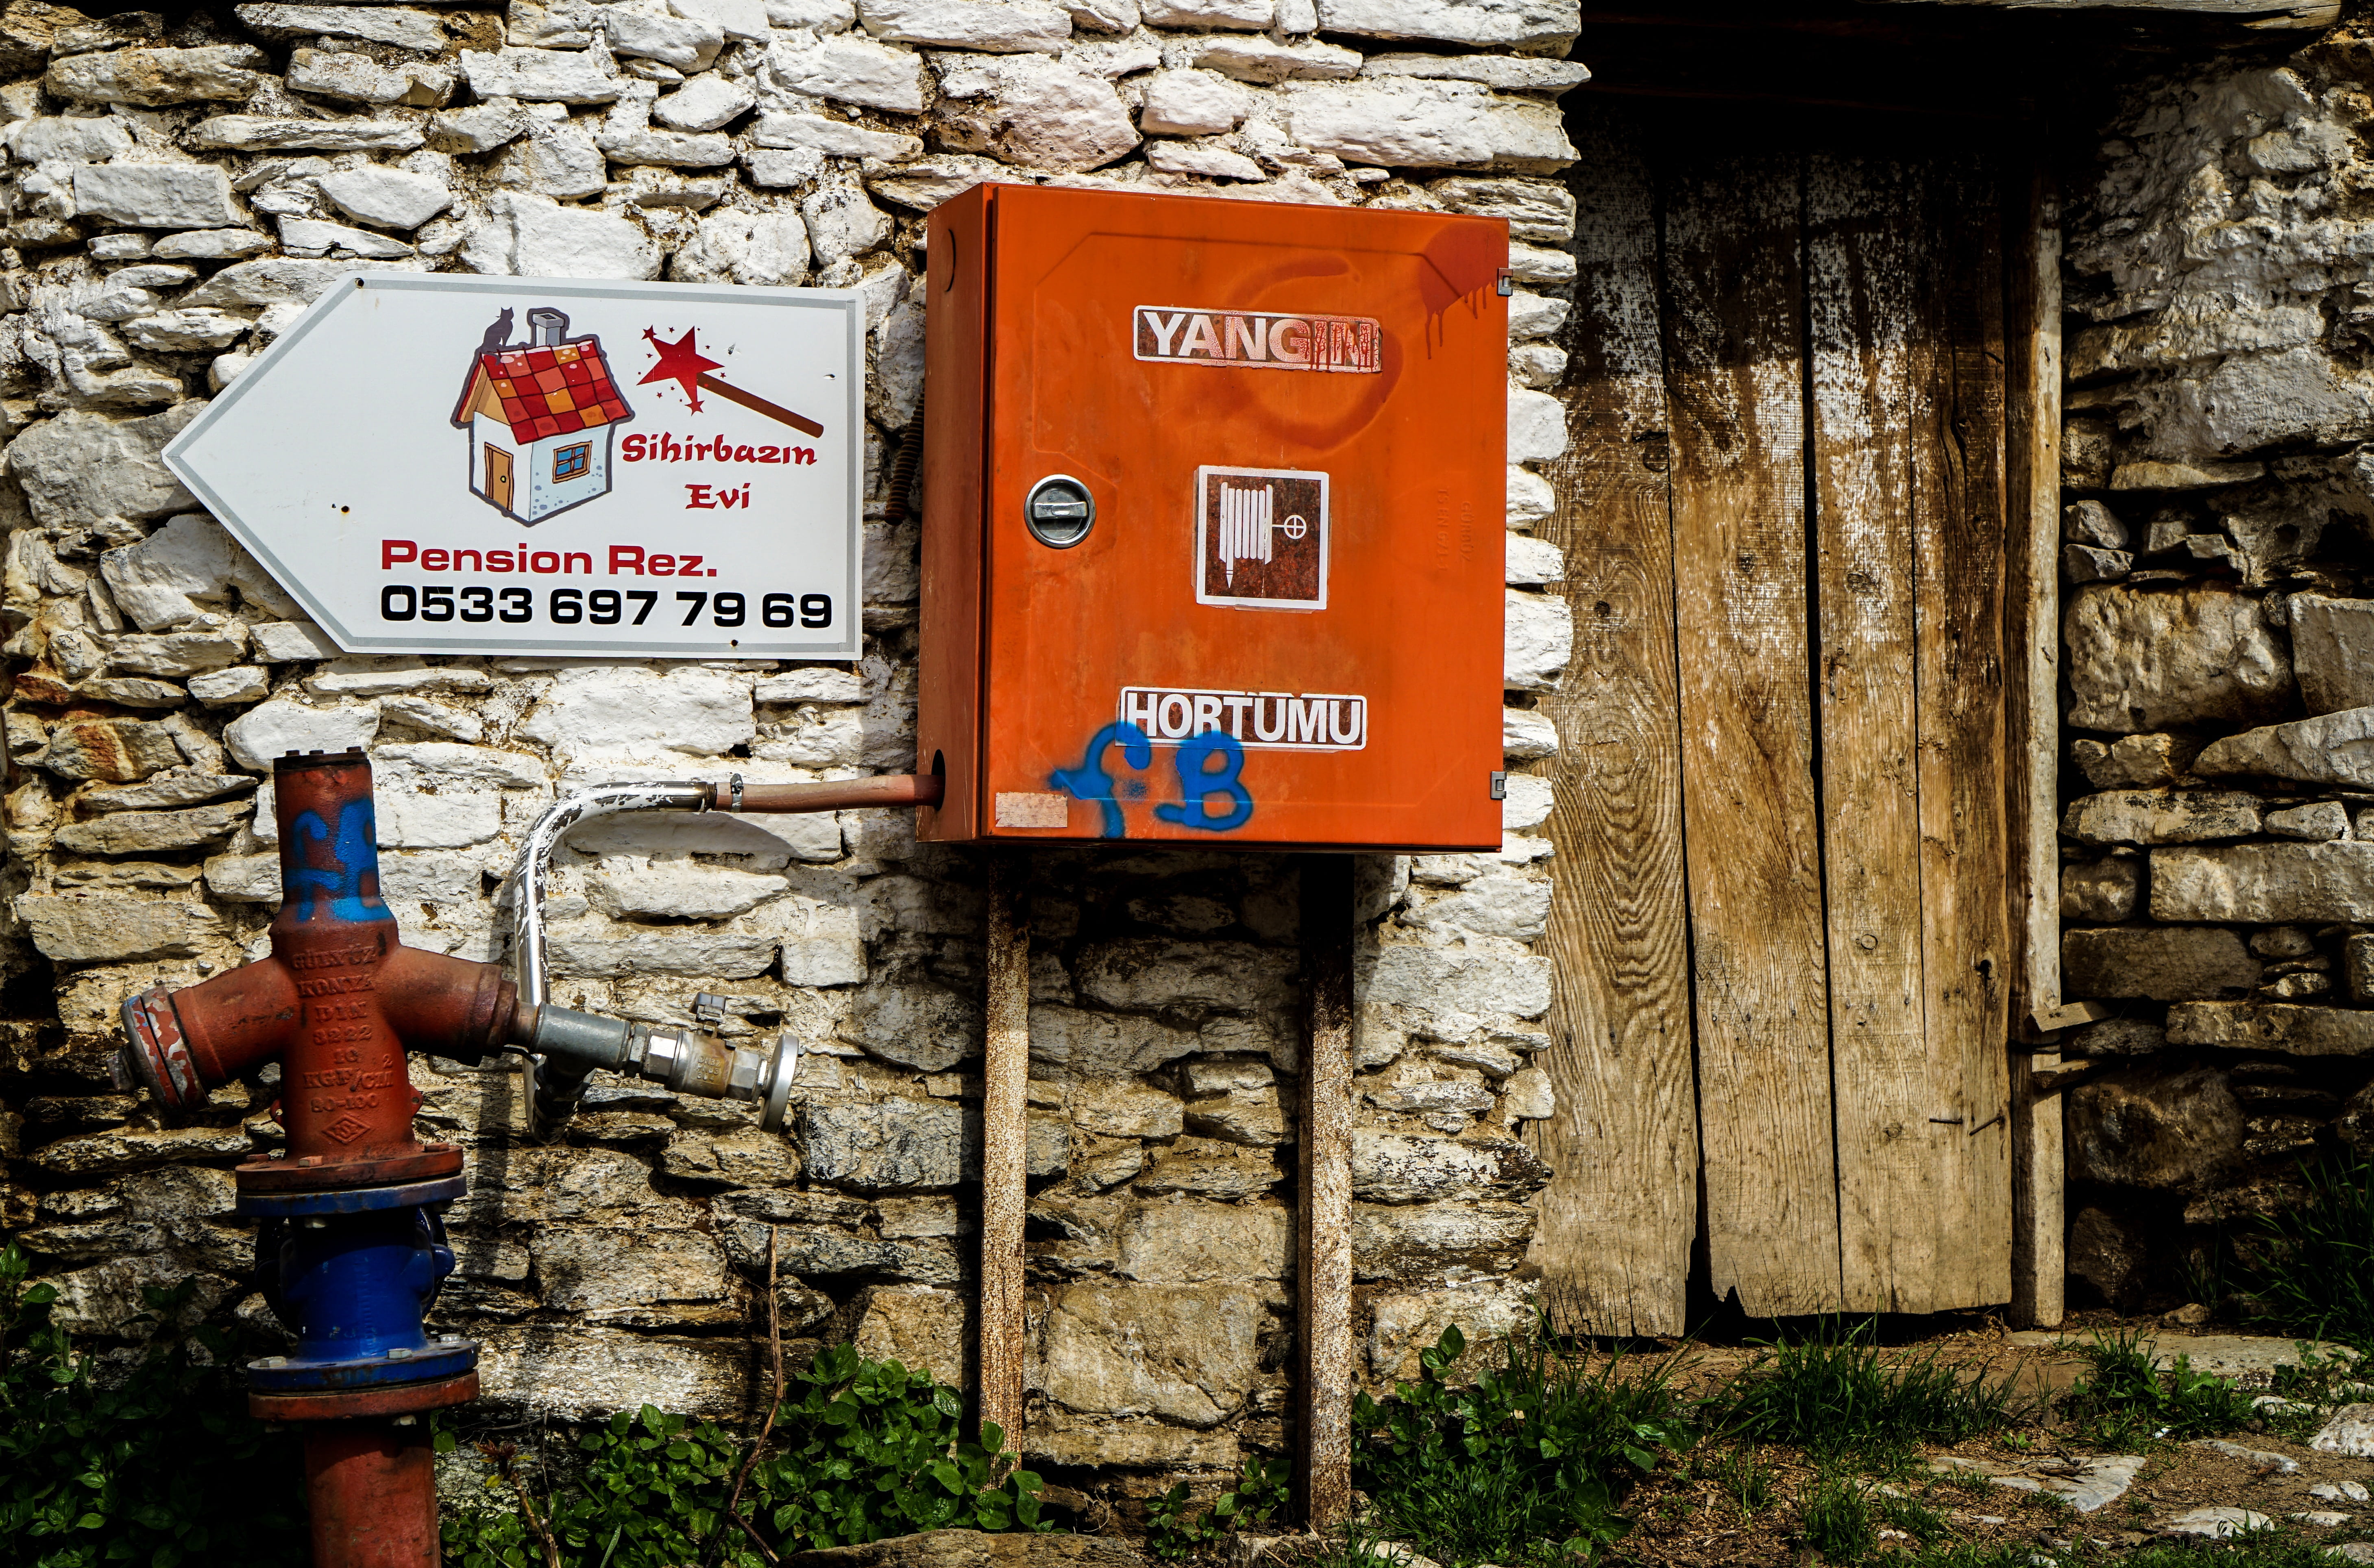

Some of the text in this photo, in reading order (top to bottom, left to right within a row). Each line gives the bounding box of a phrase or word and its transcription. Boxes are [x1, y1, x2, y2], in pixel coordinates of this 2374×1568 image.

[1143, 311, 1373, 366] YANGIN
[621, 431, 817, 465] Sihirbazın
[684, 483, 751, 509] Evi
[381, 539, 717, 577] Pension Rez.
[381, 585, 832, 628] 0533 697 79 69
[1126, 692, 1361, 744] HORTUMU
[297, 974, 375, 998] KONYA
